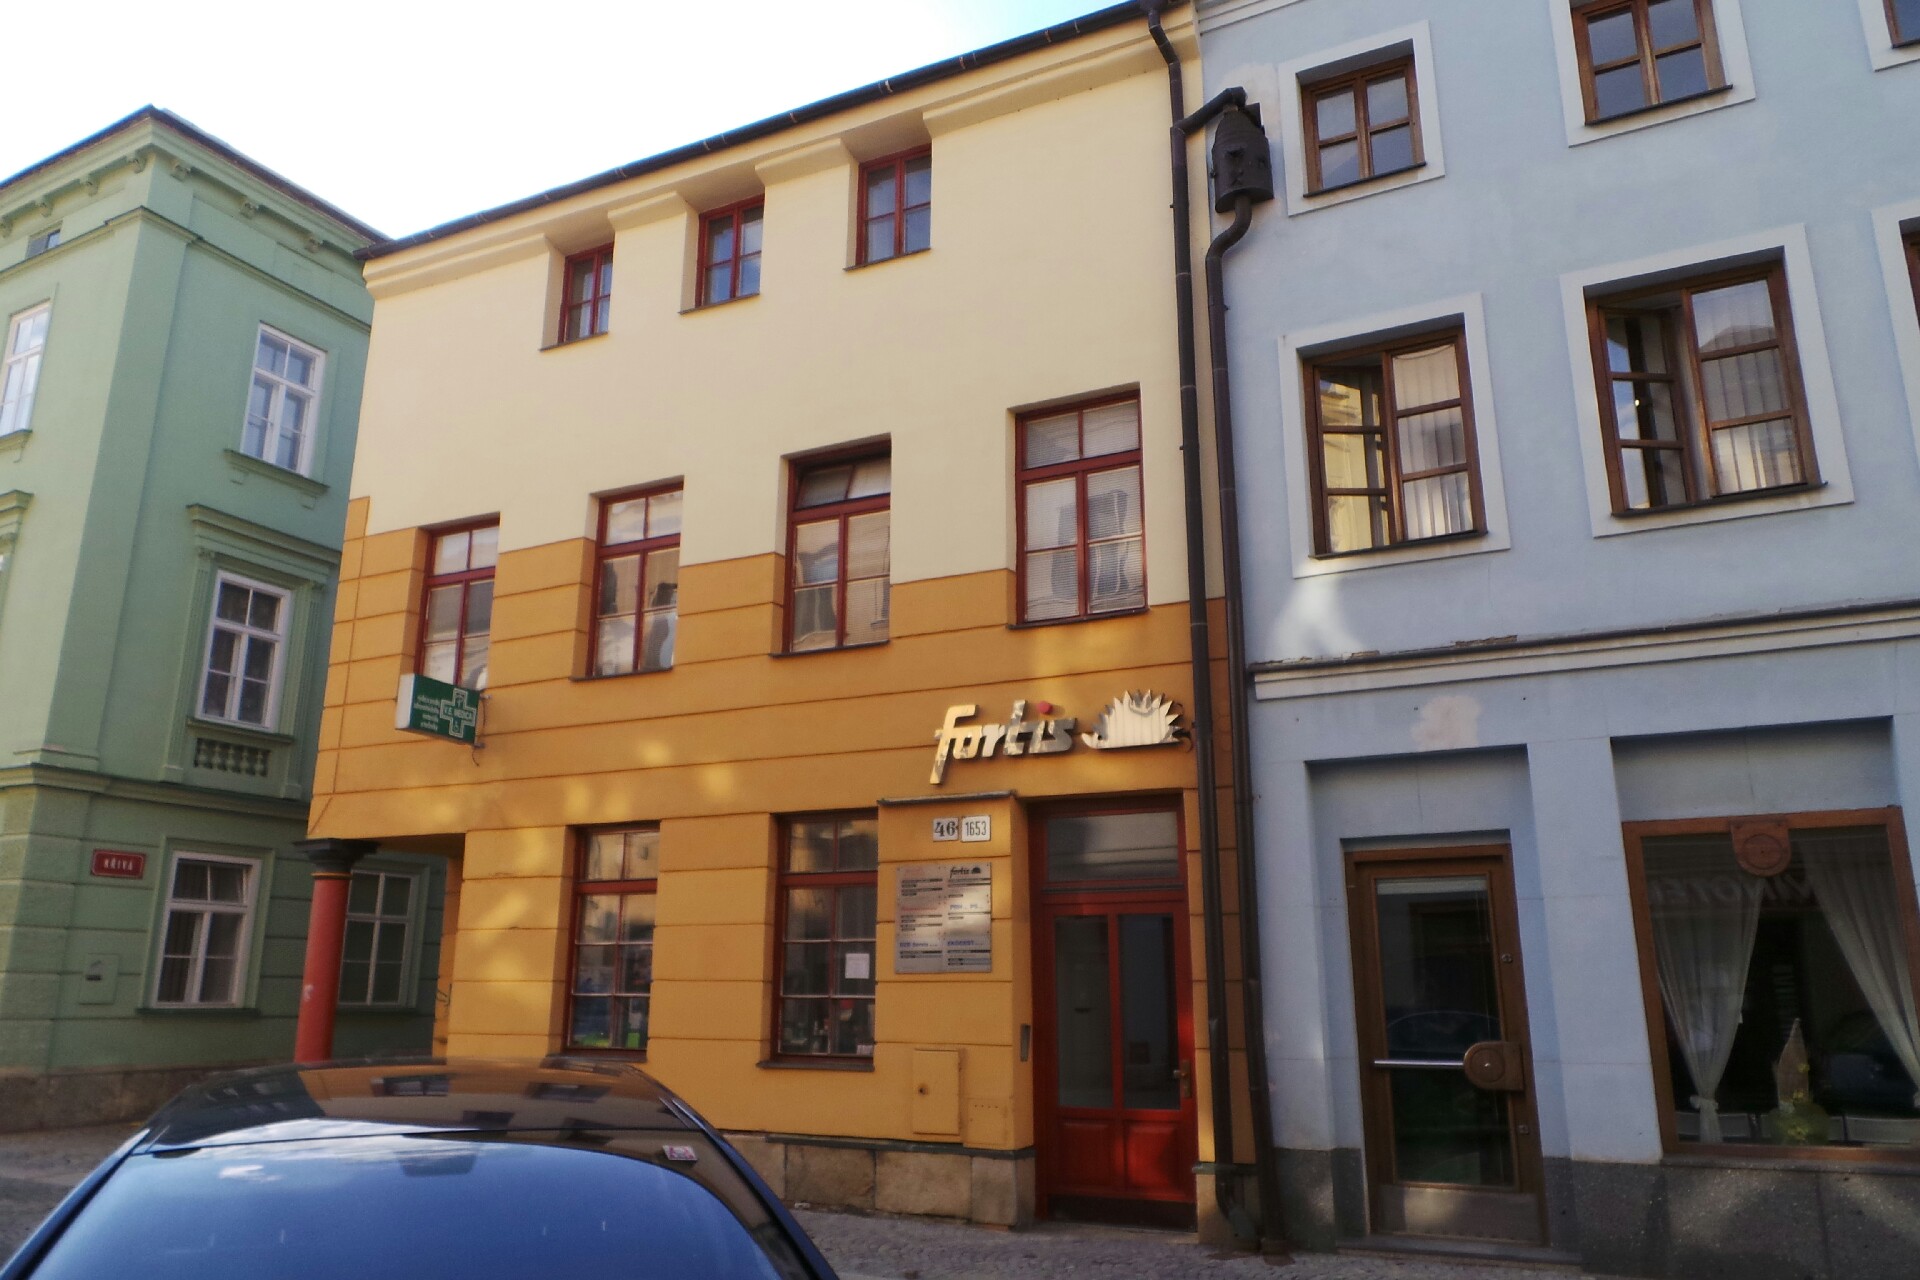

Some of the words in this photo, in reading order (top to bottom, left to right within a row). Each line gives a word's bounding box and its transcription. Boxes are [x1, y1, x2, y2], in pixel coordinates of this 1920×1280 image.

[929, 699, 1078, 785] fortis
[934, 820, 956, 837] 46
[964, 820, 987, 837] 1653
[104, 857, 133, 871] KŘIVÁ
